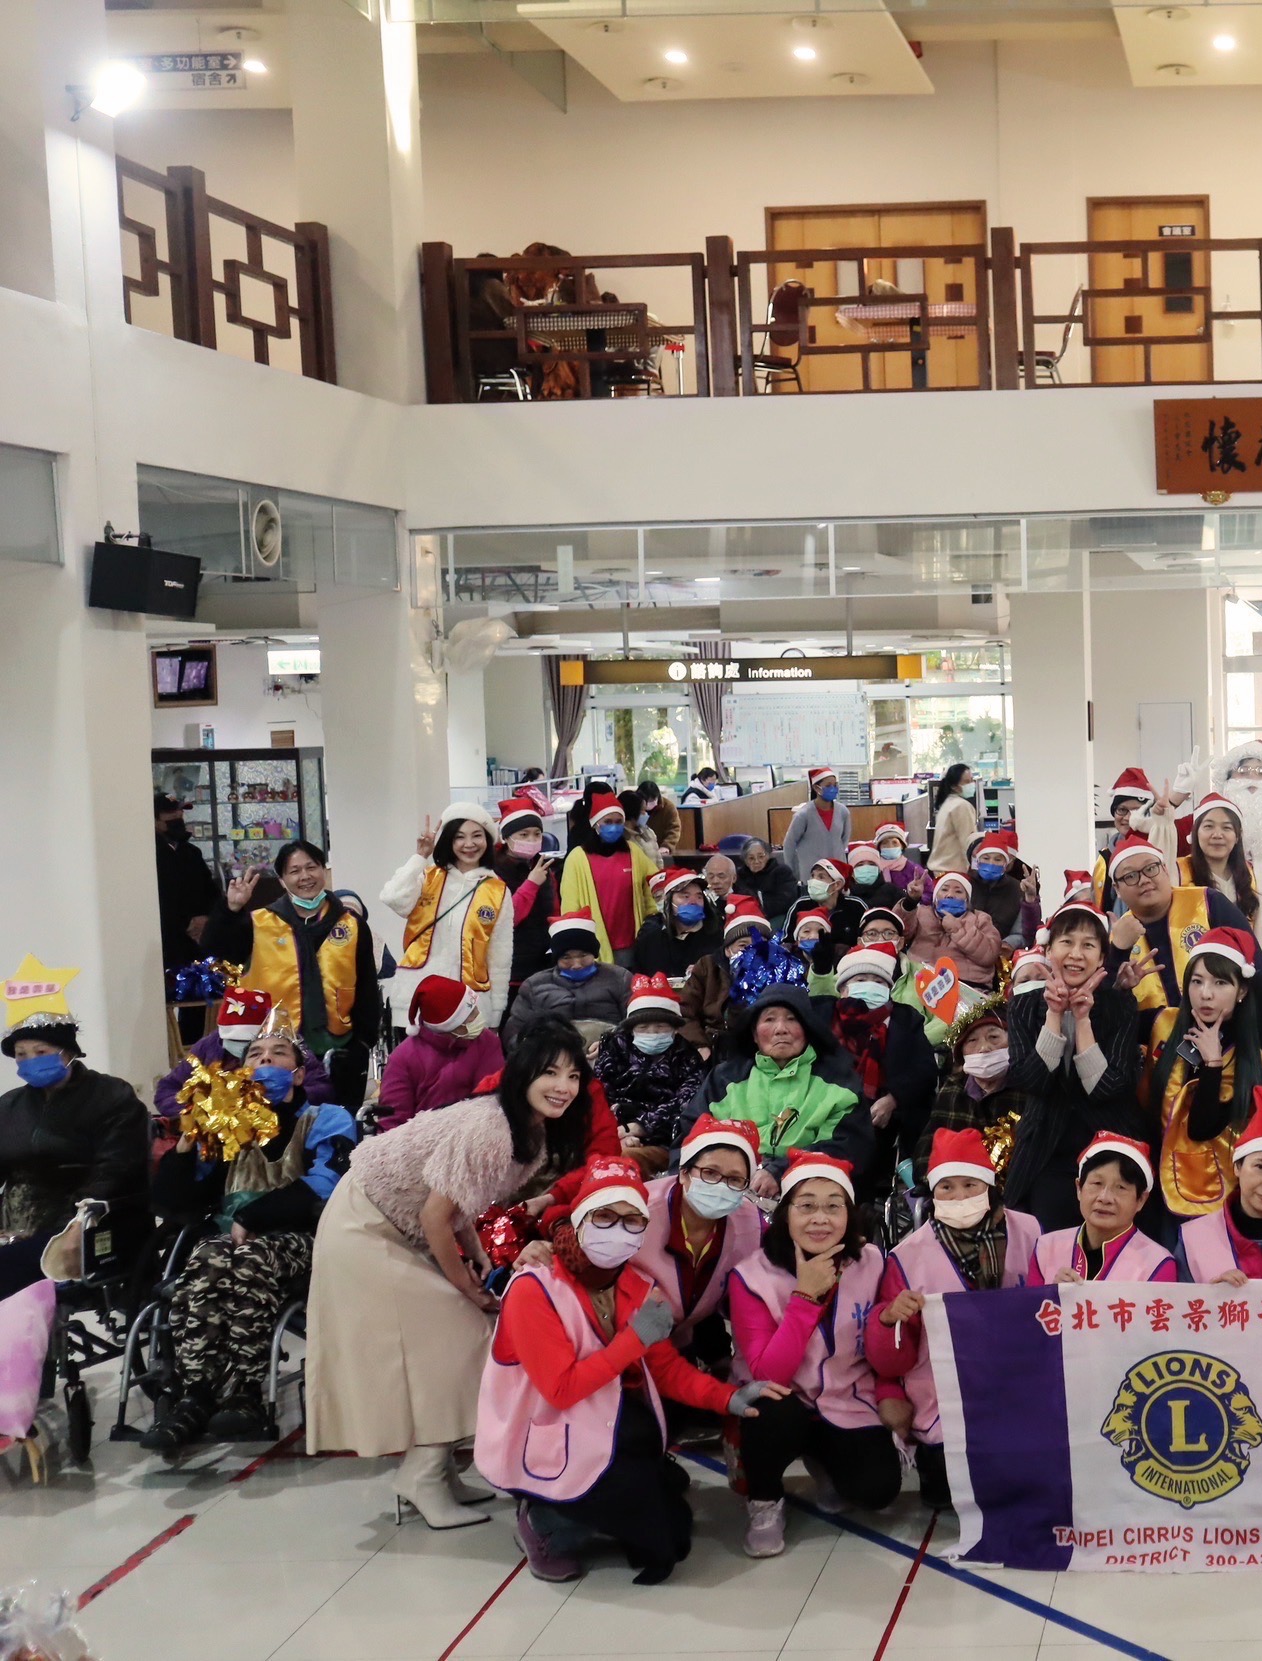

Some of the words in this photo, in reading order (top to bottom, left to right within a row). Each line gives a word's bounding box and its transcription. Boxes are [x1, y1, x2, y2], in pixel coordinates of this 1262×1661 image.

[191, 72, 222, 86] 宿舍
[690, 662, 740, 680] 諮詢處
[748, 667, 812, 679] Information
[335, 928, 344, 938] L
[1135, 1356, 1232, 1390] LIONS
[1168, 1400, 1209, 1452] L
[1141, 1465, 1233, 1495] INTERNATIONAL
[1055, 1528, 1113, 1548] TAIPEI
[1123, 1525, 1194, 1545] CIRRUS
[1203, 1527, 1260, 1545] LIONS
[1105, 1545, 1190, 1566] DISTRICT
